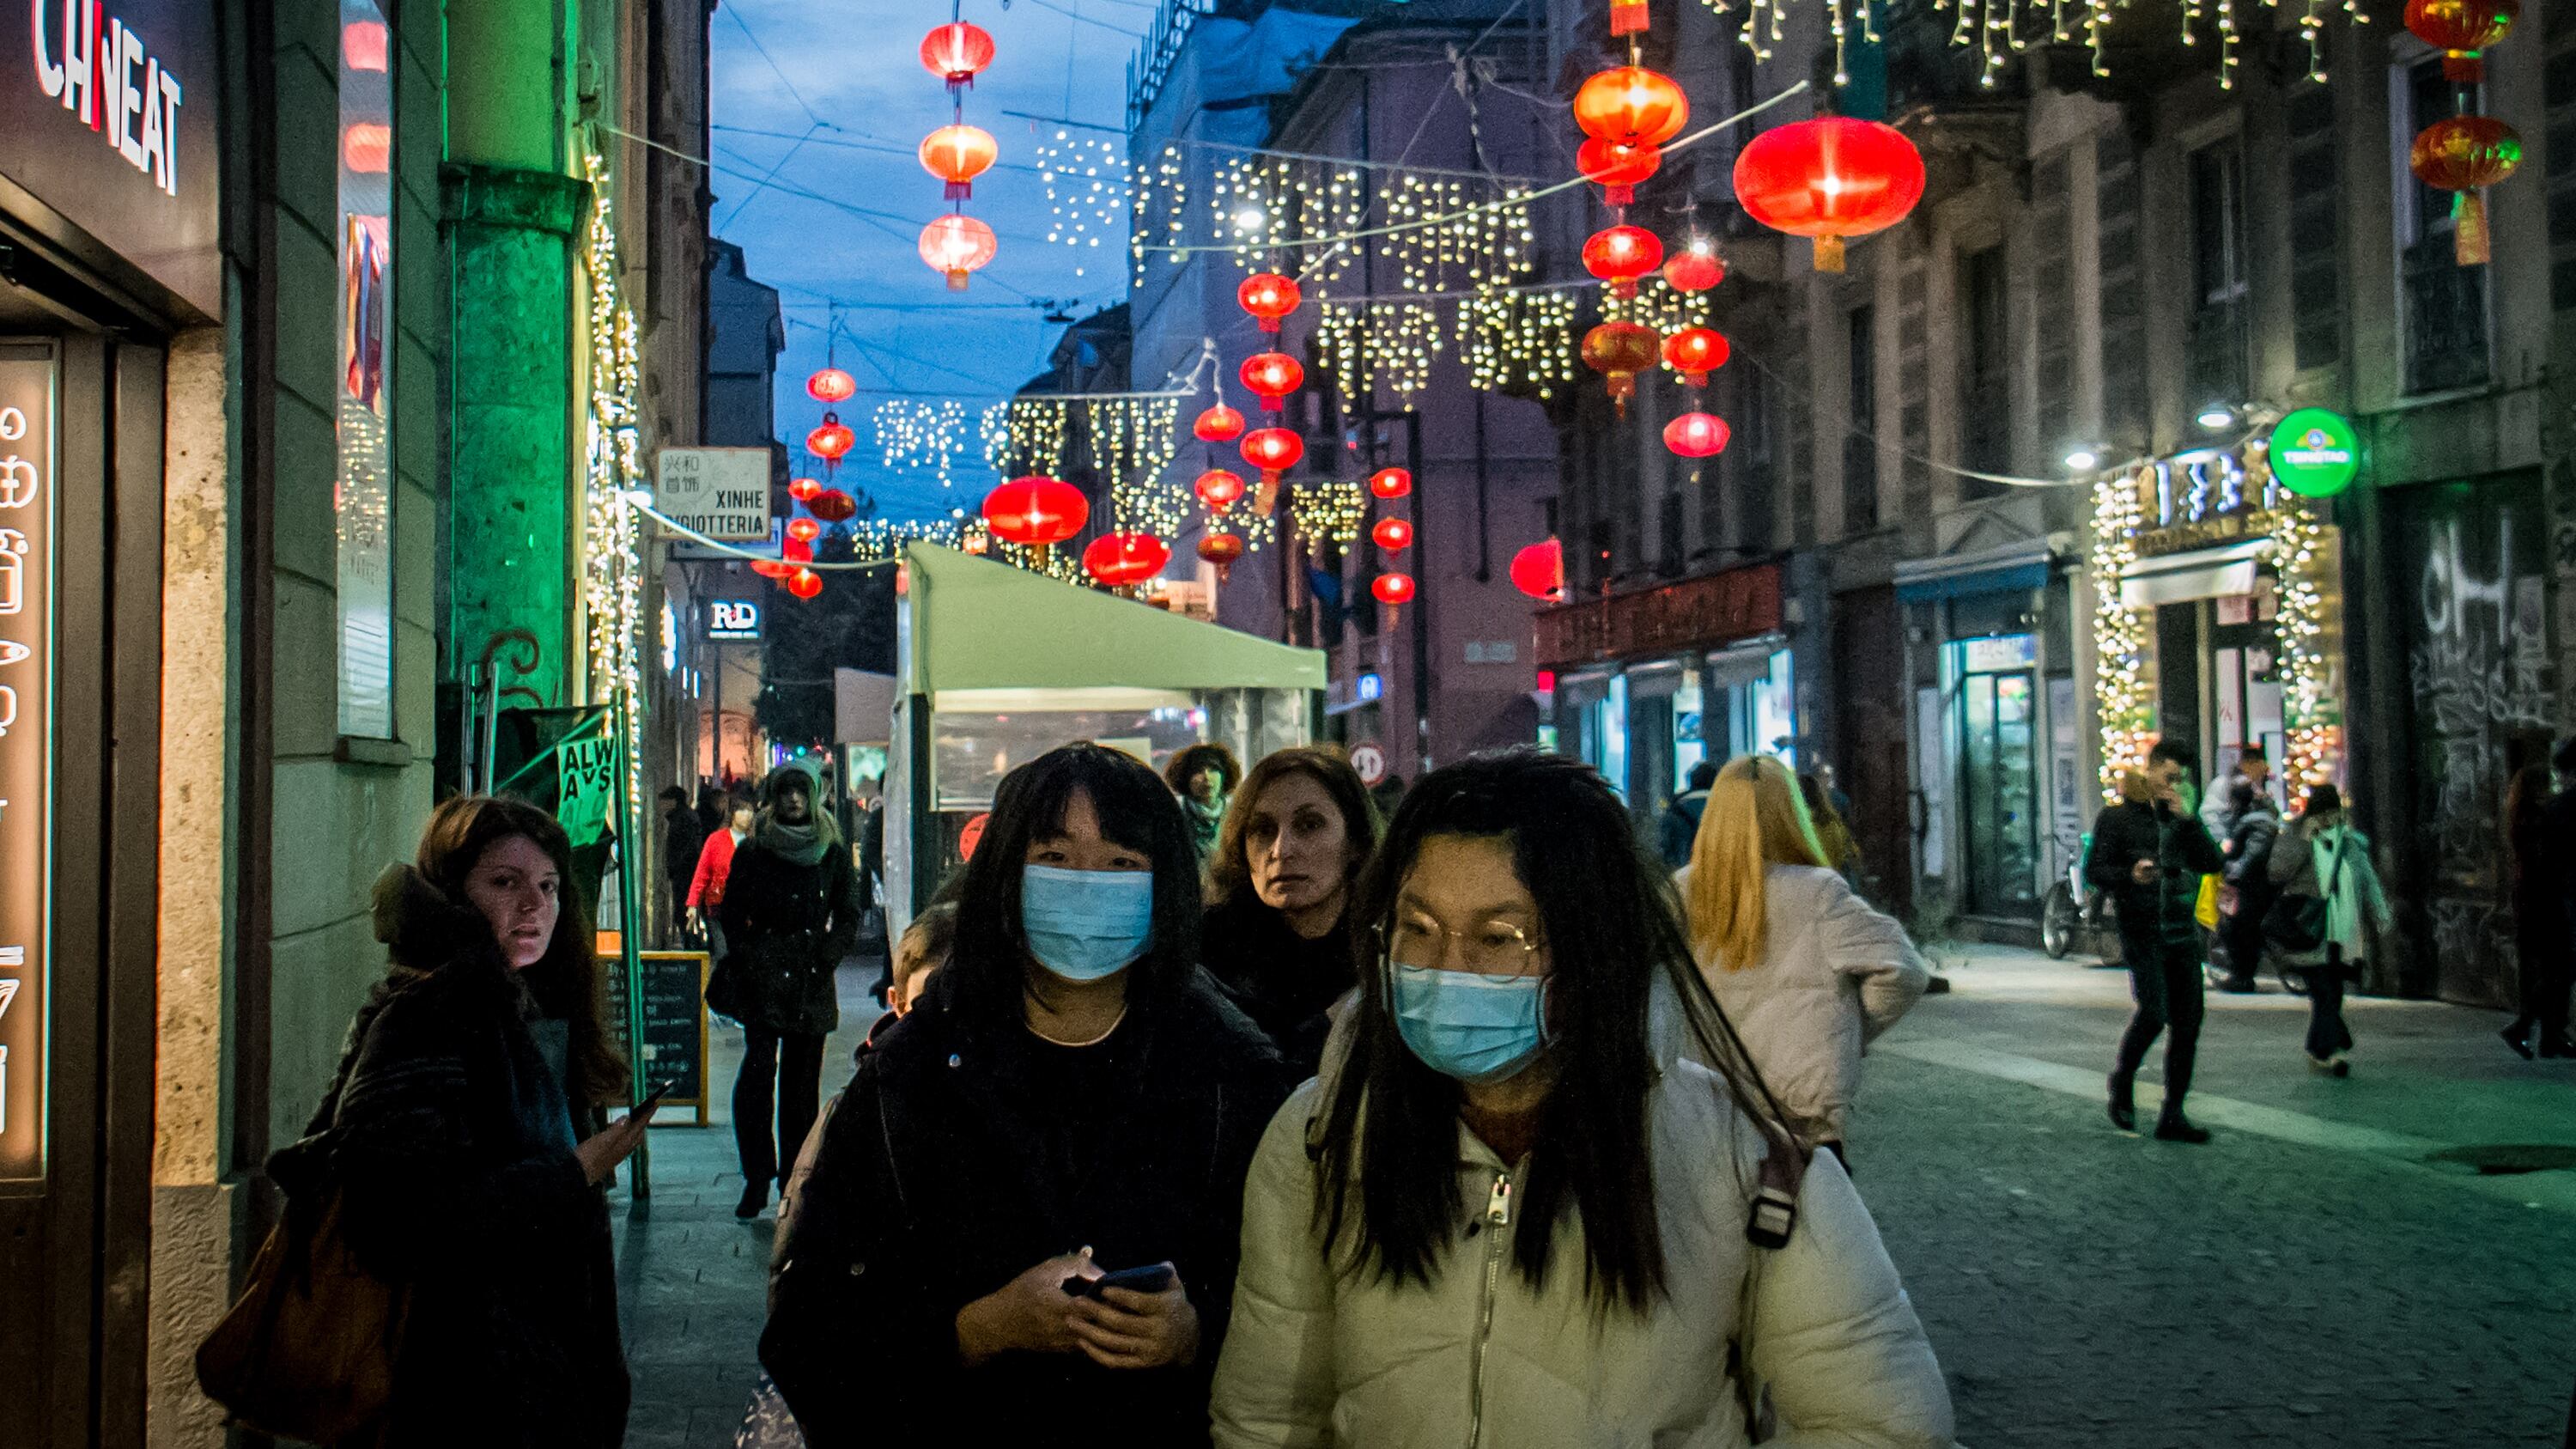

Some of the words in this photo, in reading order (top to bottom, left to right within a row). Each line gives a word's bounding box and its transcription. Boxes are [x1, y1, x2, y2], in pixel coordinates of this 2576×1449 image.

[33, 0, 181, 197] CHINEAT
[716, 490, 763, 508] XINHE
[563, 739, 614, 774] ALW
